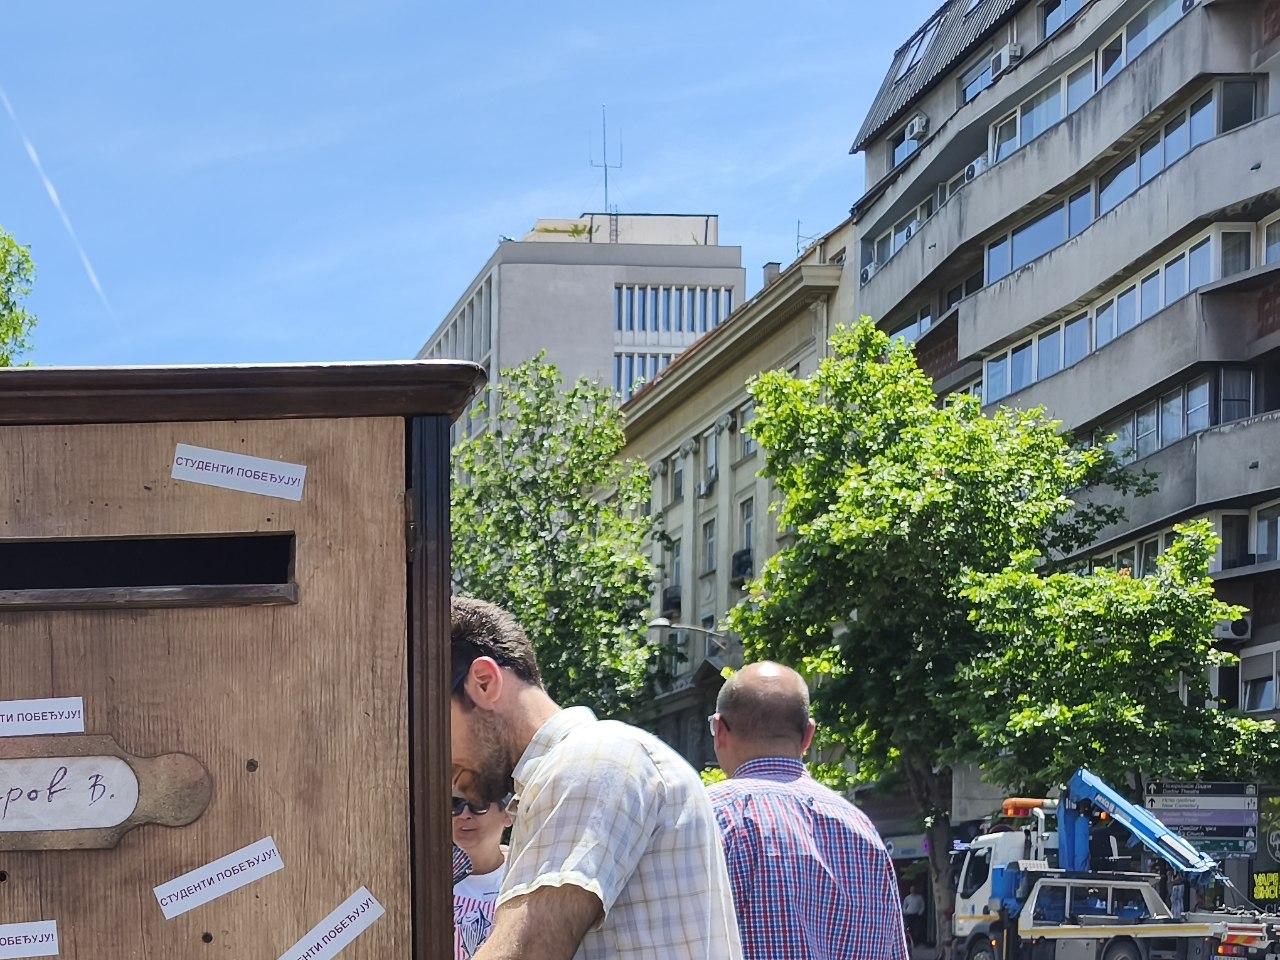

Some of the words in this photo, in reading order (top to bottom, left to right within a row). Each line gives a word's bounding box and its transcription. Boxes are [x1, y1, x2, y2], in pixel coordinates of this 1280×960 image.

[176, 456, 234, 475] СТУДЕНТИ
[236, 467, 301, 487] ПОБЕЂУЈУ!
[17, 709, 81, 722] ПОБЕЂУЈУ!
[88, 774, 115, 807] В.
[160, 877, 215, 906] СТУДЕНТИ
[216, 849, 277, 881] ПОБЕЂУЈУ!
[1253, 873, 1279, 887] VAPE
[321, 897, 374, 945] ПОБЕЂУЈУ!
